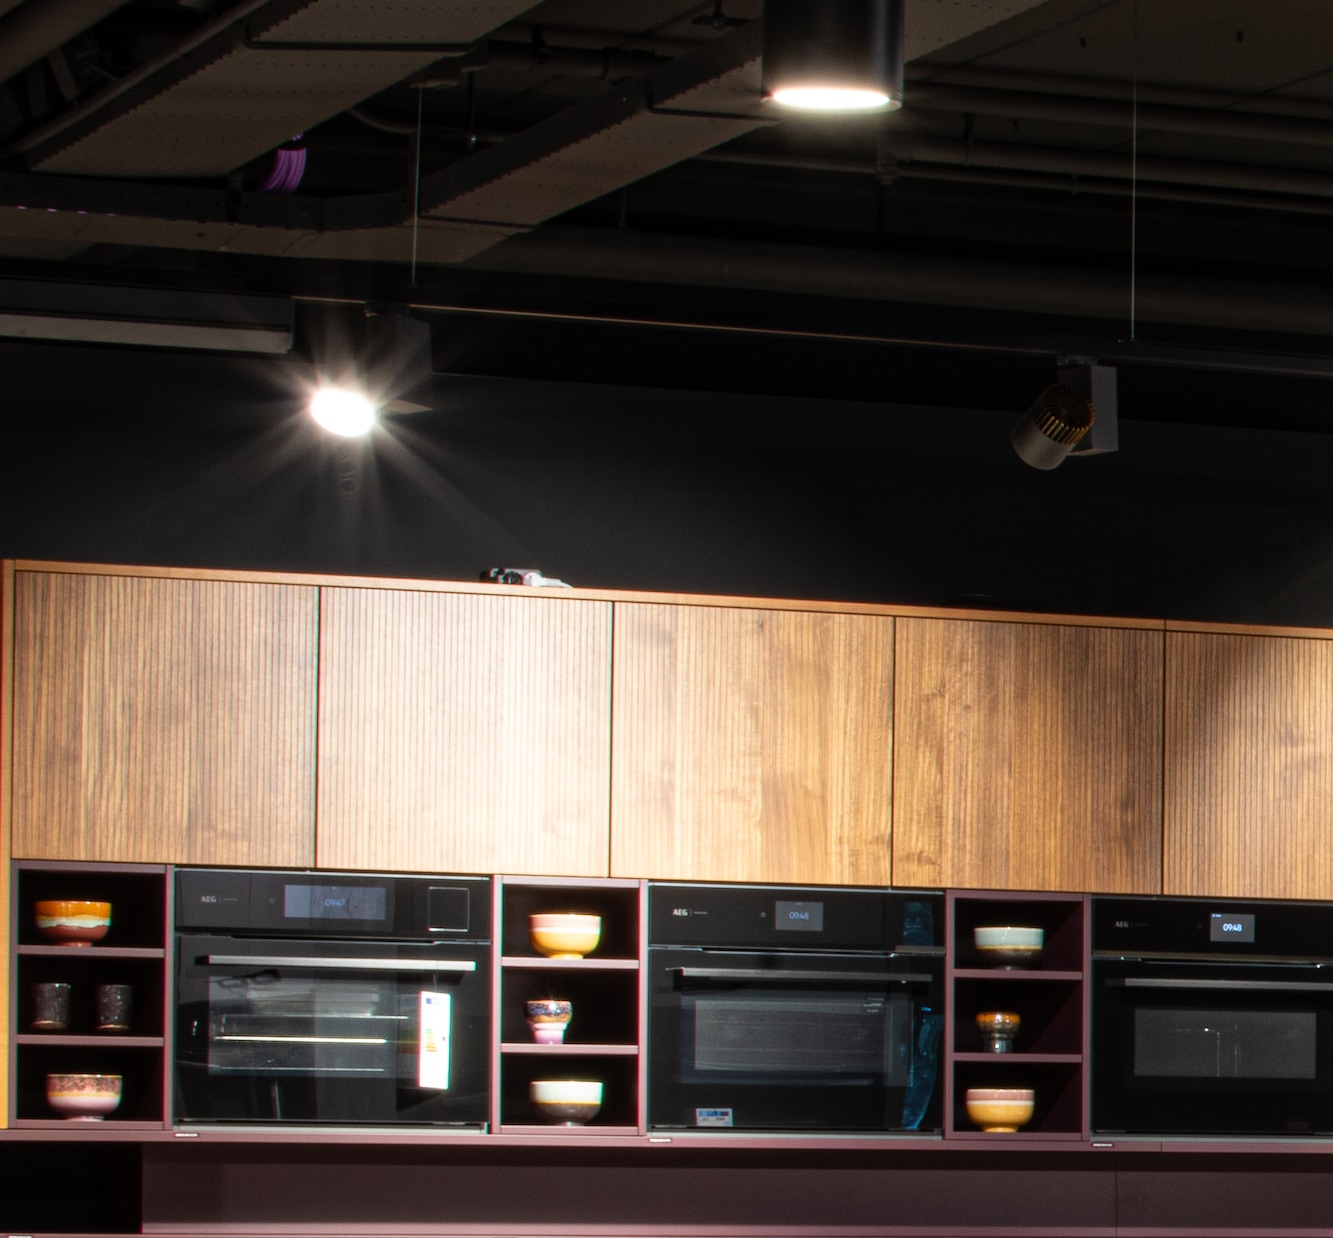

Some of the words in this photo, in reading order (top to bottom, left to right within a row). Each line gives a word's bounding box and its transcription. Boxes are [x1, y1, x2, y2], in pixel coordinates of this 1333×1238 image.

[200, 895, 218, 904] AEG
[672, 908, 690, 917] AEG
[1114, 920, 1130, 929] AEG
